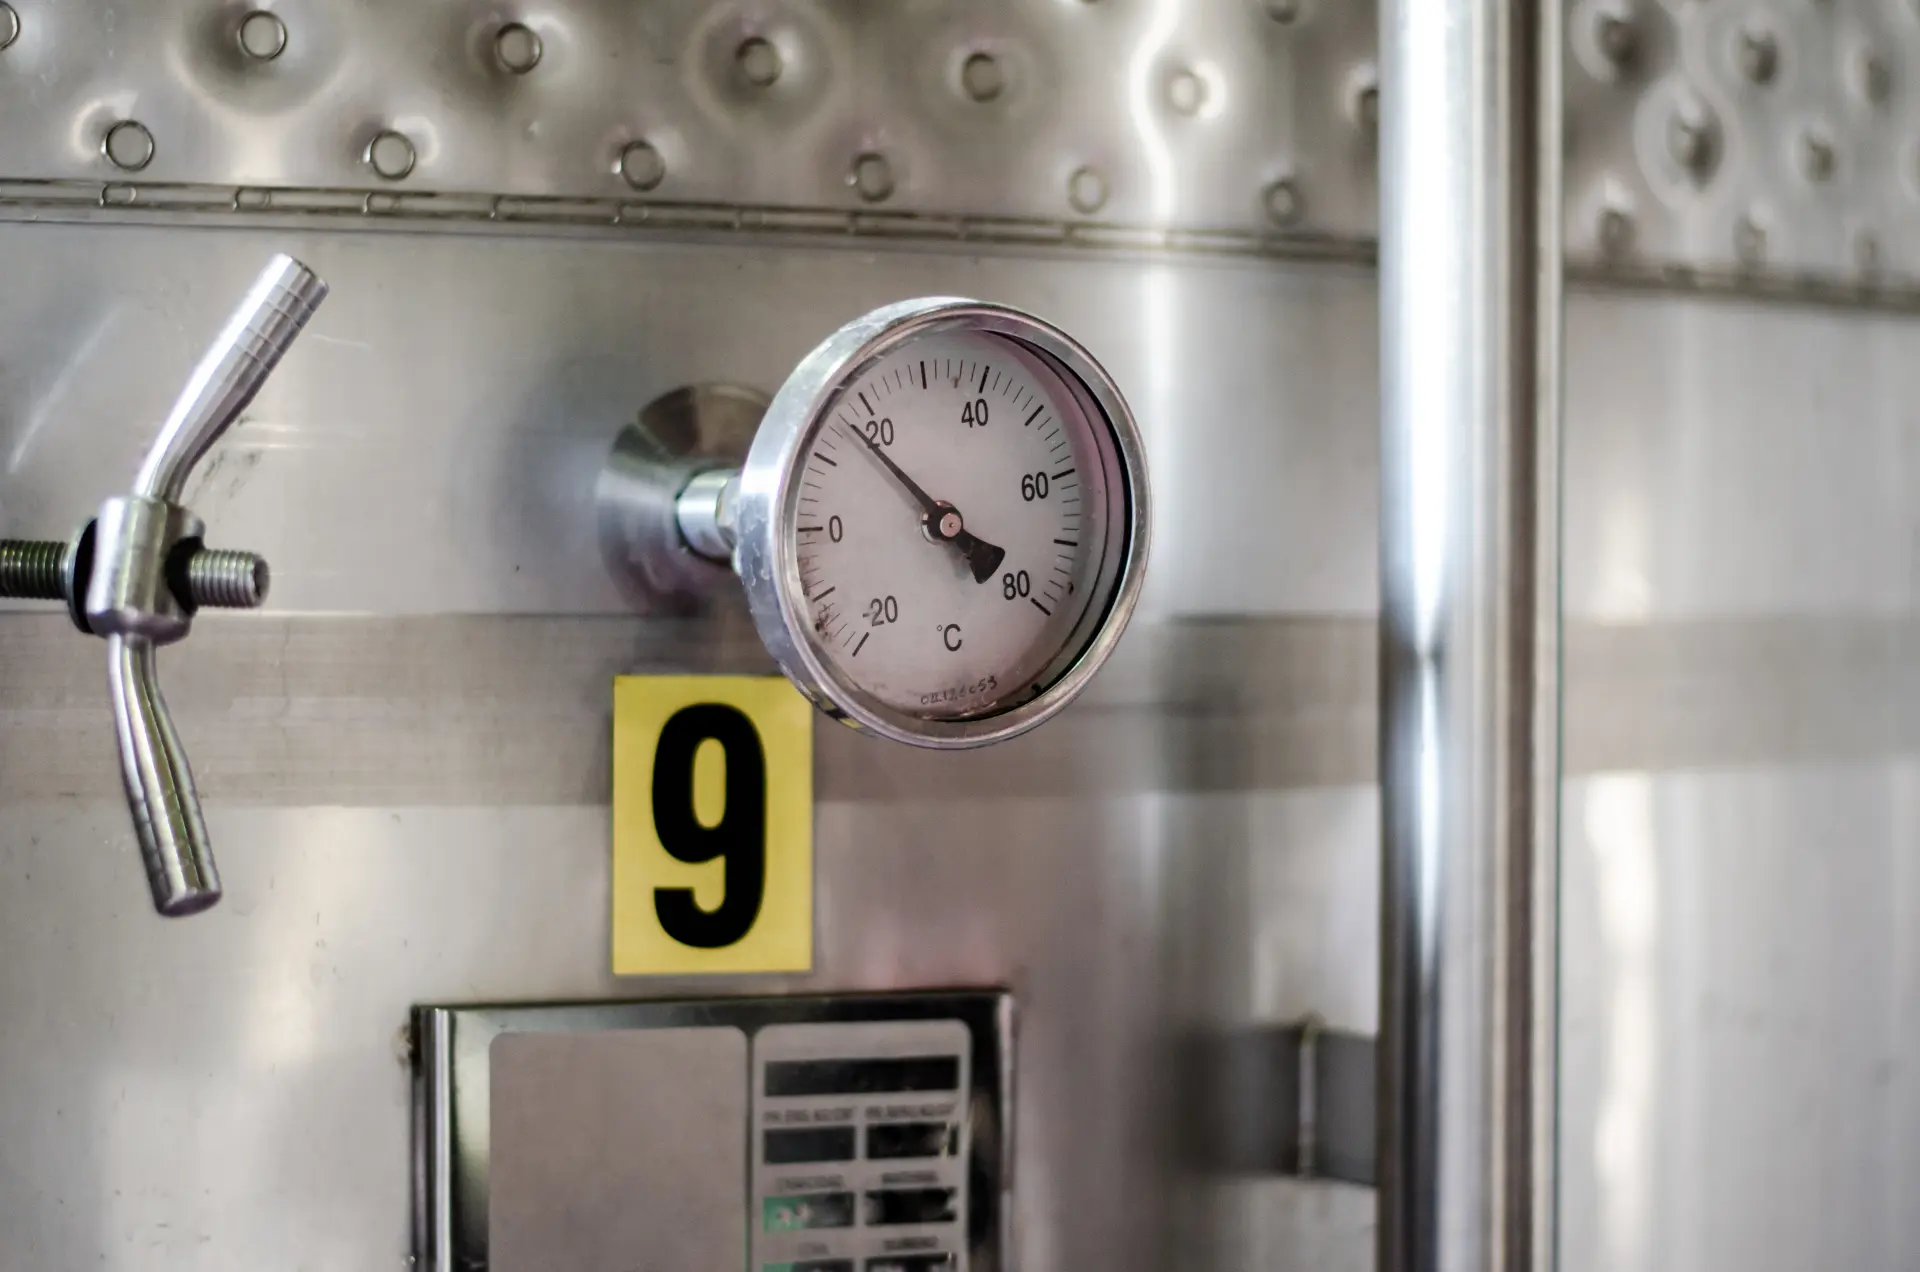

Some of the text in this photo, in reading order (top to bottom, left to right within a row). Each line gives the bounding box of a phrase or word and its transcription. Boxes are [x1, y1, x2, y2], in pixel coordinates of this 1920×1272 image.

[961, 398, 989, 428] 40
[866, 417, 894, 447] 20
[1021, 472, 1049, 502] 60
[828, 515, 843, 543] 0
[1003, 570, 1031, 601] 80
[652, 702, 767, 949] 9
